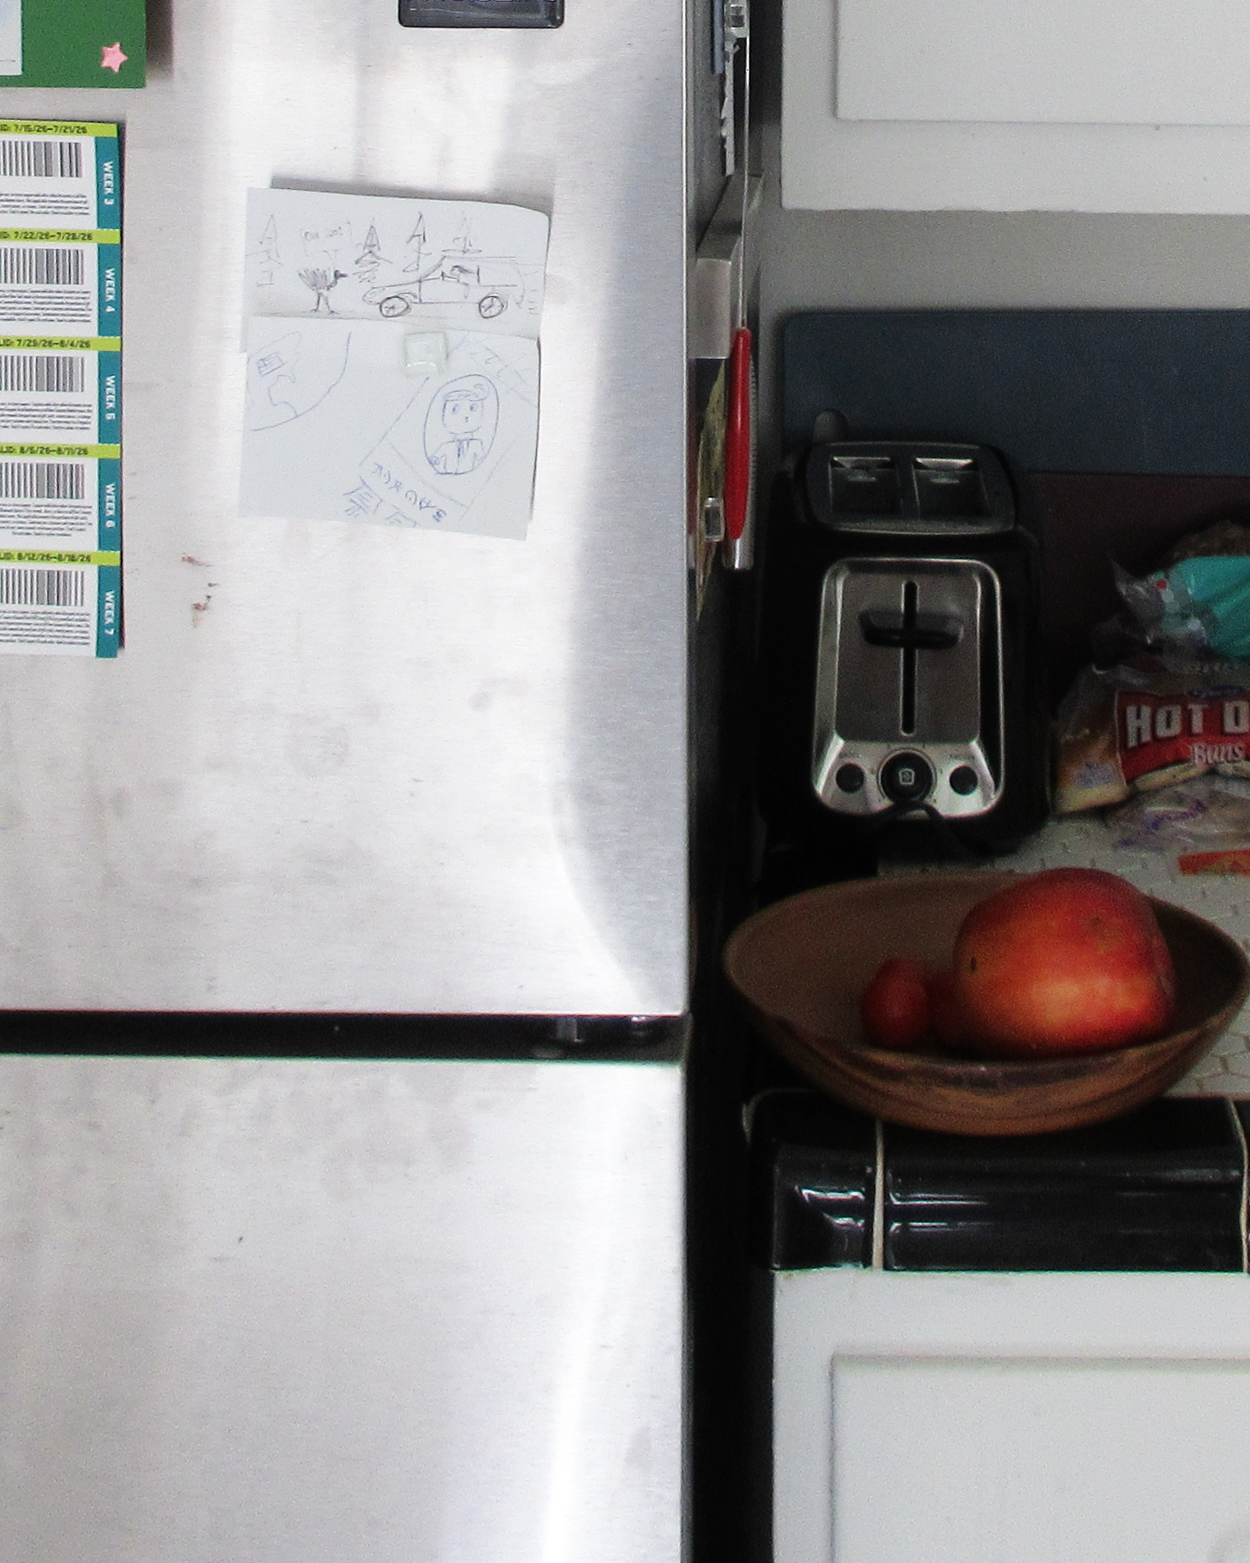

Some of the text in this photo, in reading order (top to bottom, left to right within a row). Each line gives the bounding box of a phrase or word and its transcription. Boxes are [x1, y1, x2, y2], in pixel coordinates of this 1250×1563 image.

[103, 160, 114, 194] WEEK
[105, 268, 115, 302] WEEK
[105, 375, 116, 409] WEEK
[105, 483, 116, 517] WEEK
[104, 590, 115, 625] WEEK
[1126, 703, 1209, 748] HOT
